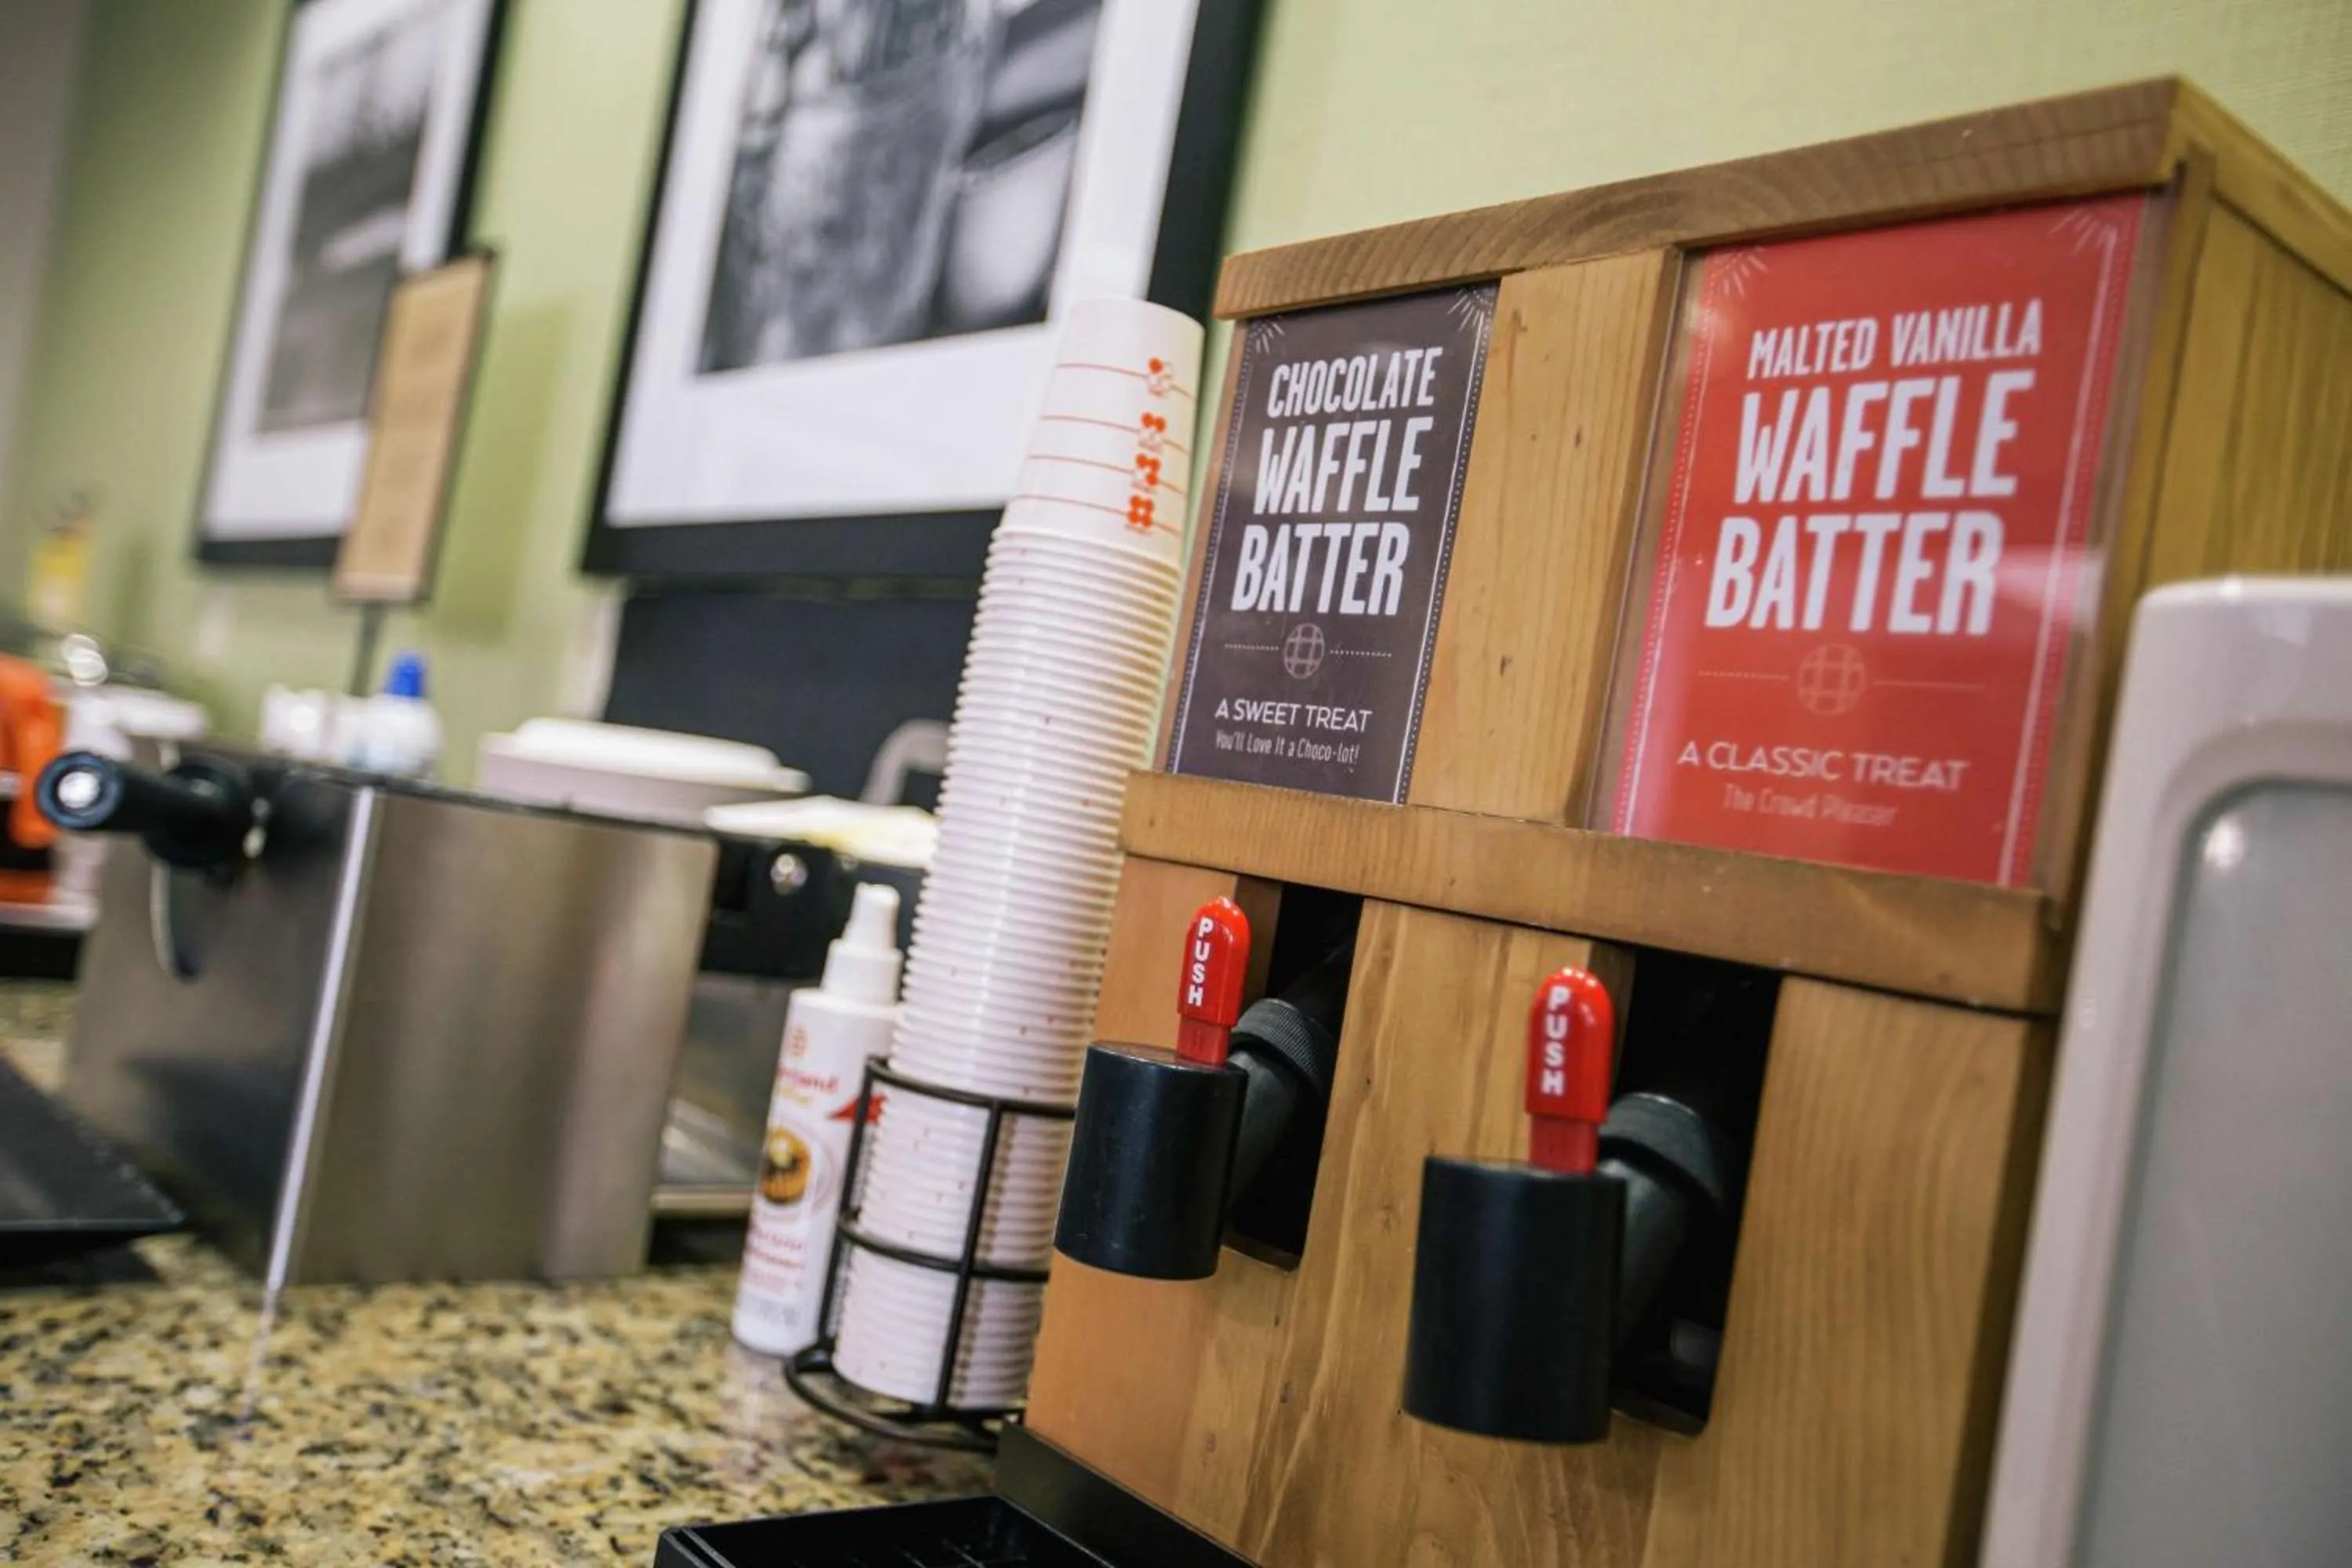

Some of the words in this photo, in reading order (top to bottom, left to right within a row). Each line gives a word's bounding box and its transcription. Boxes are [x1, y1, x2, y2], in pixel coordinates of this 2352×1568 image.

[1267, 347, 1443, 418] CHOCOLATE
[1747, 318, 1878, 380] MALTED
[1890, 299, 2042, 367] VANILLA
[1254, 416, 1434, 514] WAFFLE
[1734, 369, 2034, 503] WAFFLE
[1230, 521, 1410, 615] BATTER
[1705, 511, 2004, 636] BATTER
[1214, 698, 1229, 719] A
[1232, 699, 1301, 726] SWEET
[1305, 705, 1373, 733] TREAT
[1216, 729, 1245, 752] You'll
[1247, 732, 1272, 754] Love
[1287, 741, 1295, 757] a
[1297, 738, 1360, 764] Choco-lot!
[1676, 740, 1700, 766] A
[1707, 741, 1843, 780] CLASSIC
[1851, 752, 1970, 791] TREAT
[1188, 916, 1214, 1007] PUSH
[1541, 985, 1571, 1096] PUSH
